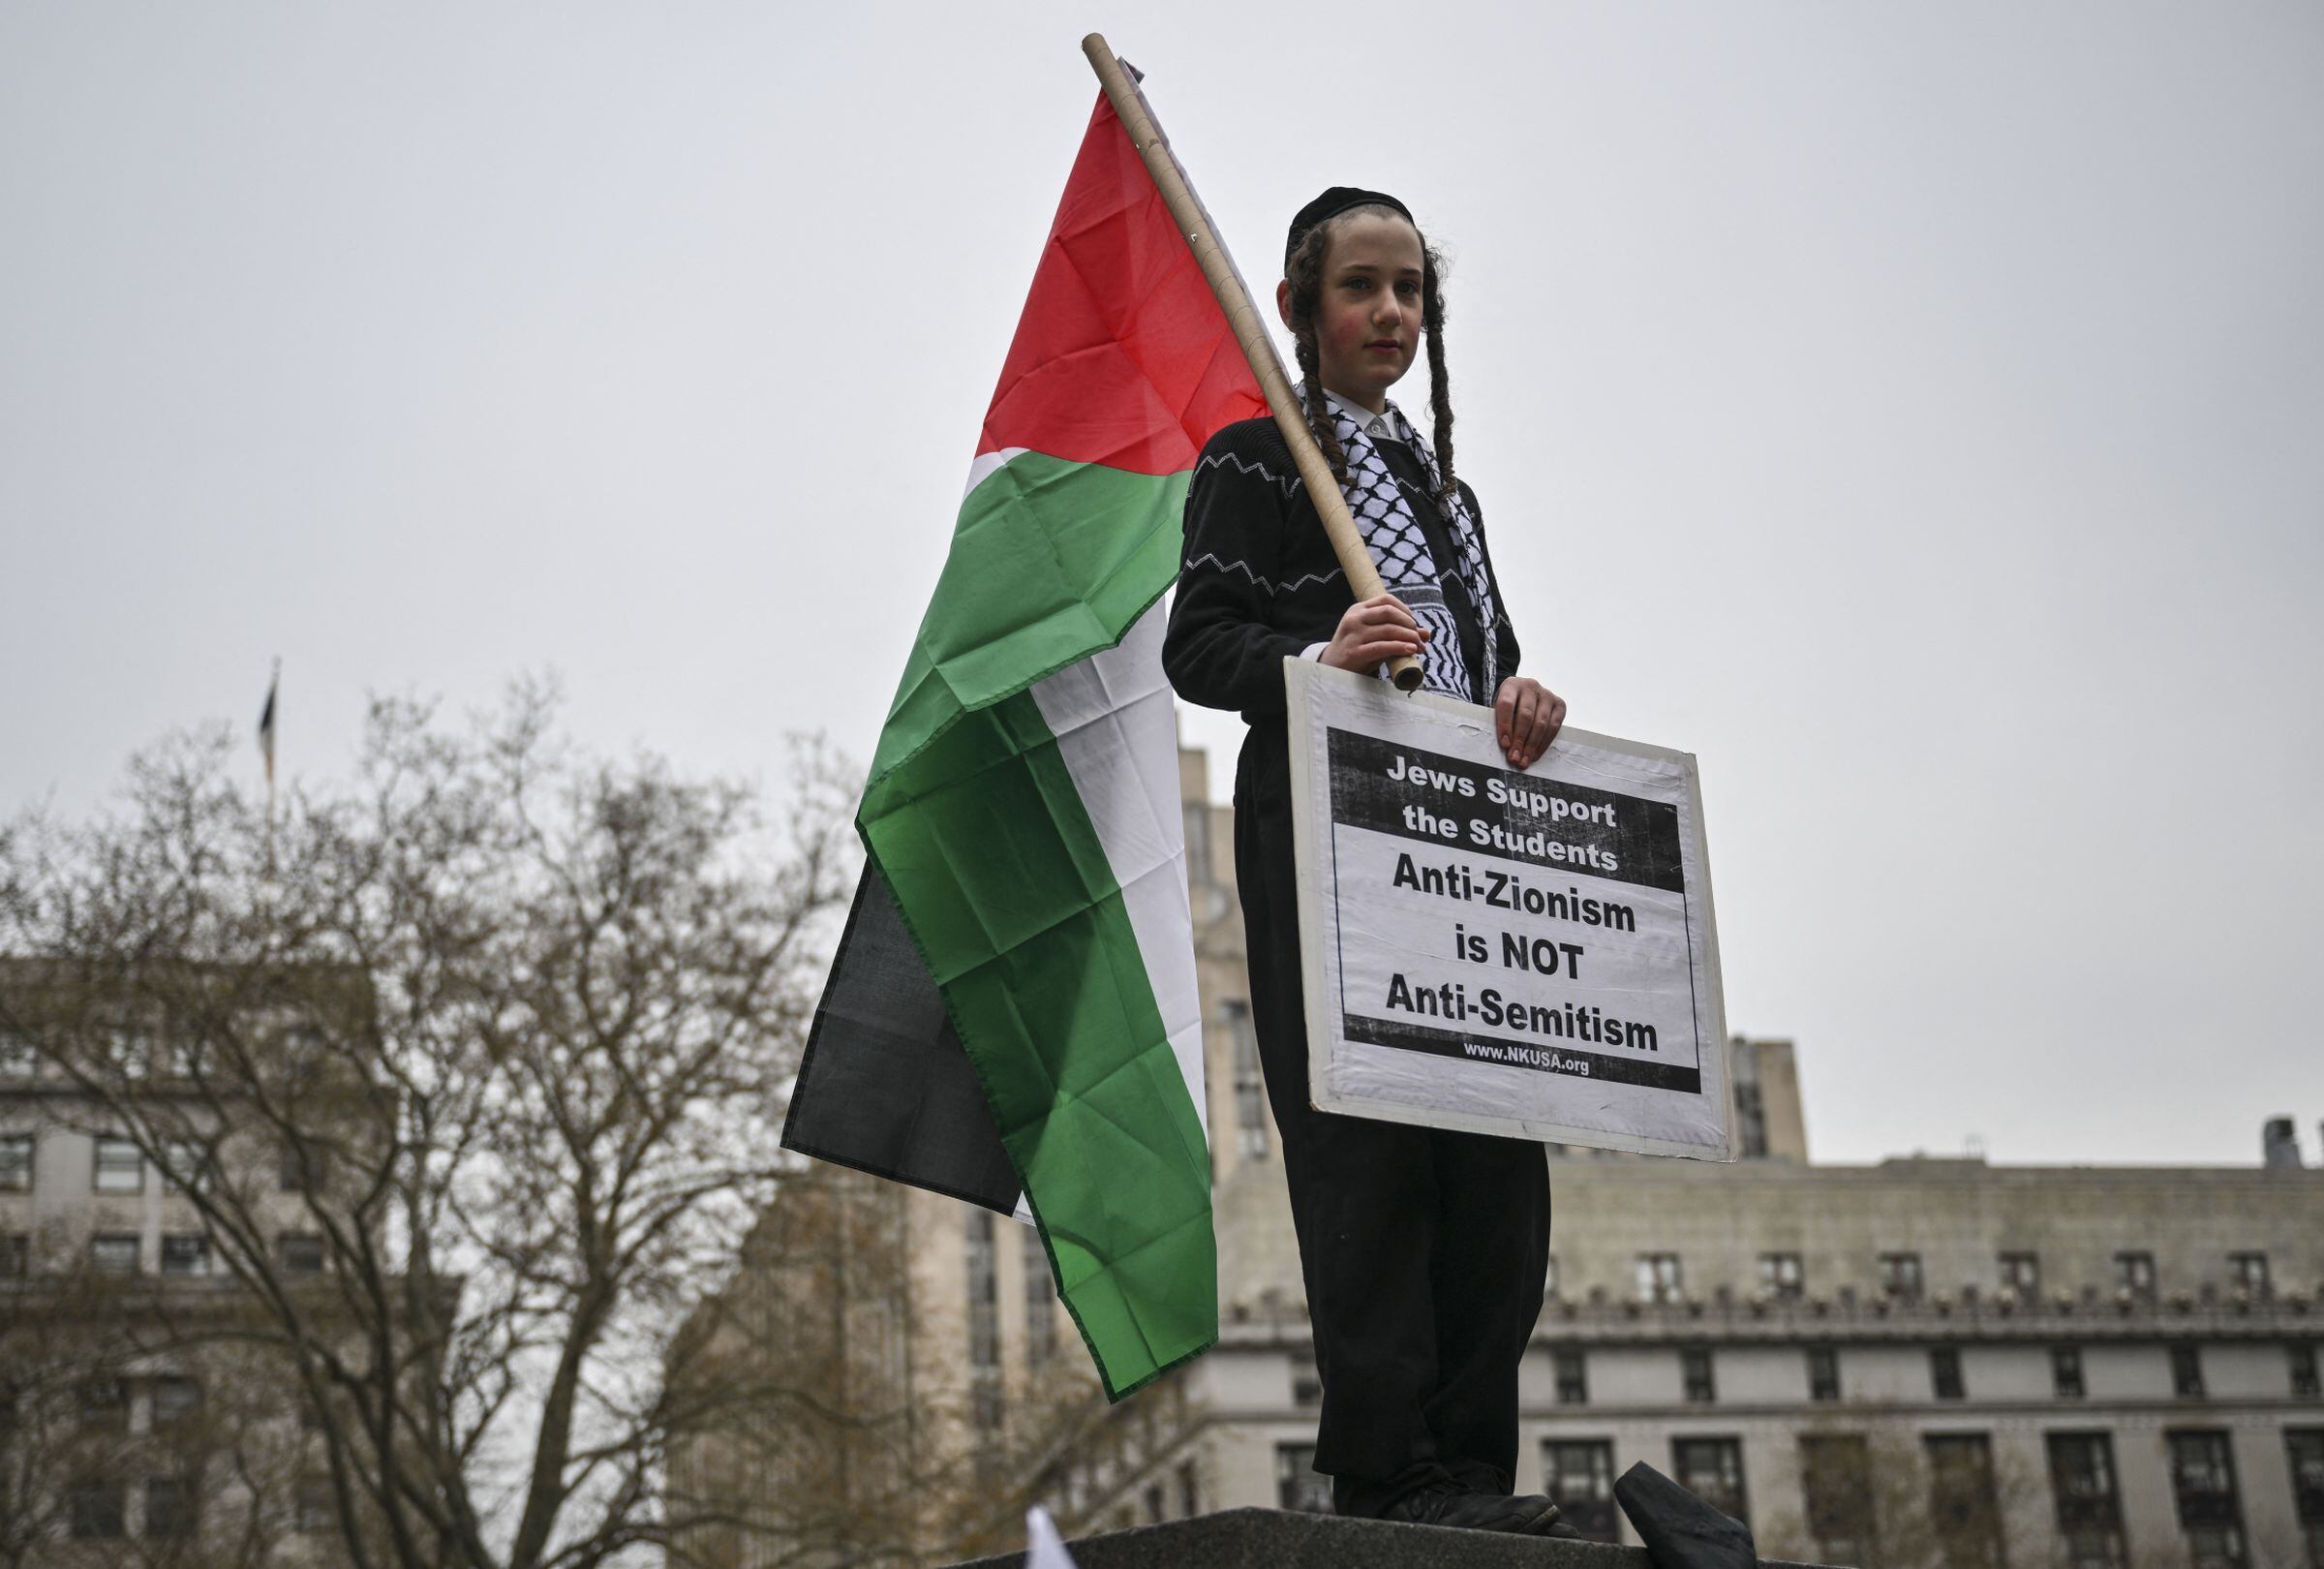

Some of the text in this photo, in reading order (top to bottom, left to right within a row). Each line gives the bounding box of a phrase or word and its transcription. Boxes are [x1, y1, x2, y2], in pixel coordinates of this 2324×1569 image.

[1387, 756, 1616, 826] Jews Support
[1402, 805, 1617, 871] the Students
[1392, 852, 1636, 932] Anti-Zionism
[1455, 924, 1584, 979] is NOT
[1387, 974, 1658, 1051] Anti-Semitism
[1464, 1043, 1589, 1076] www.NKUSA.org
